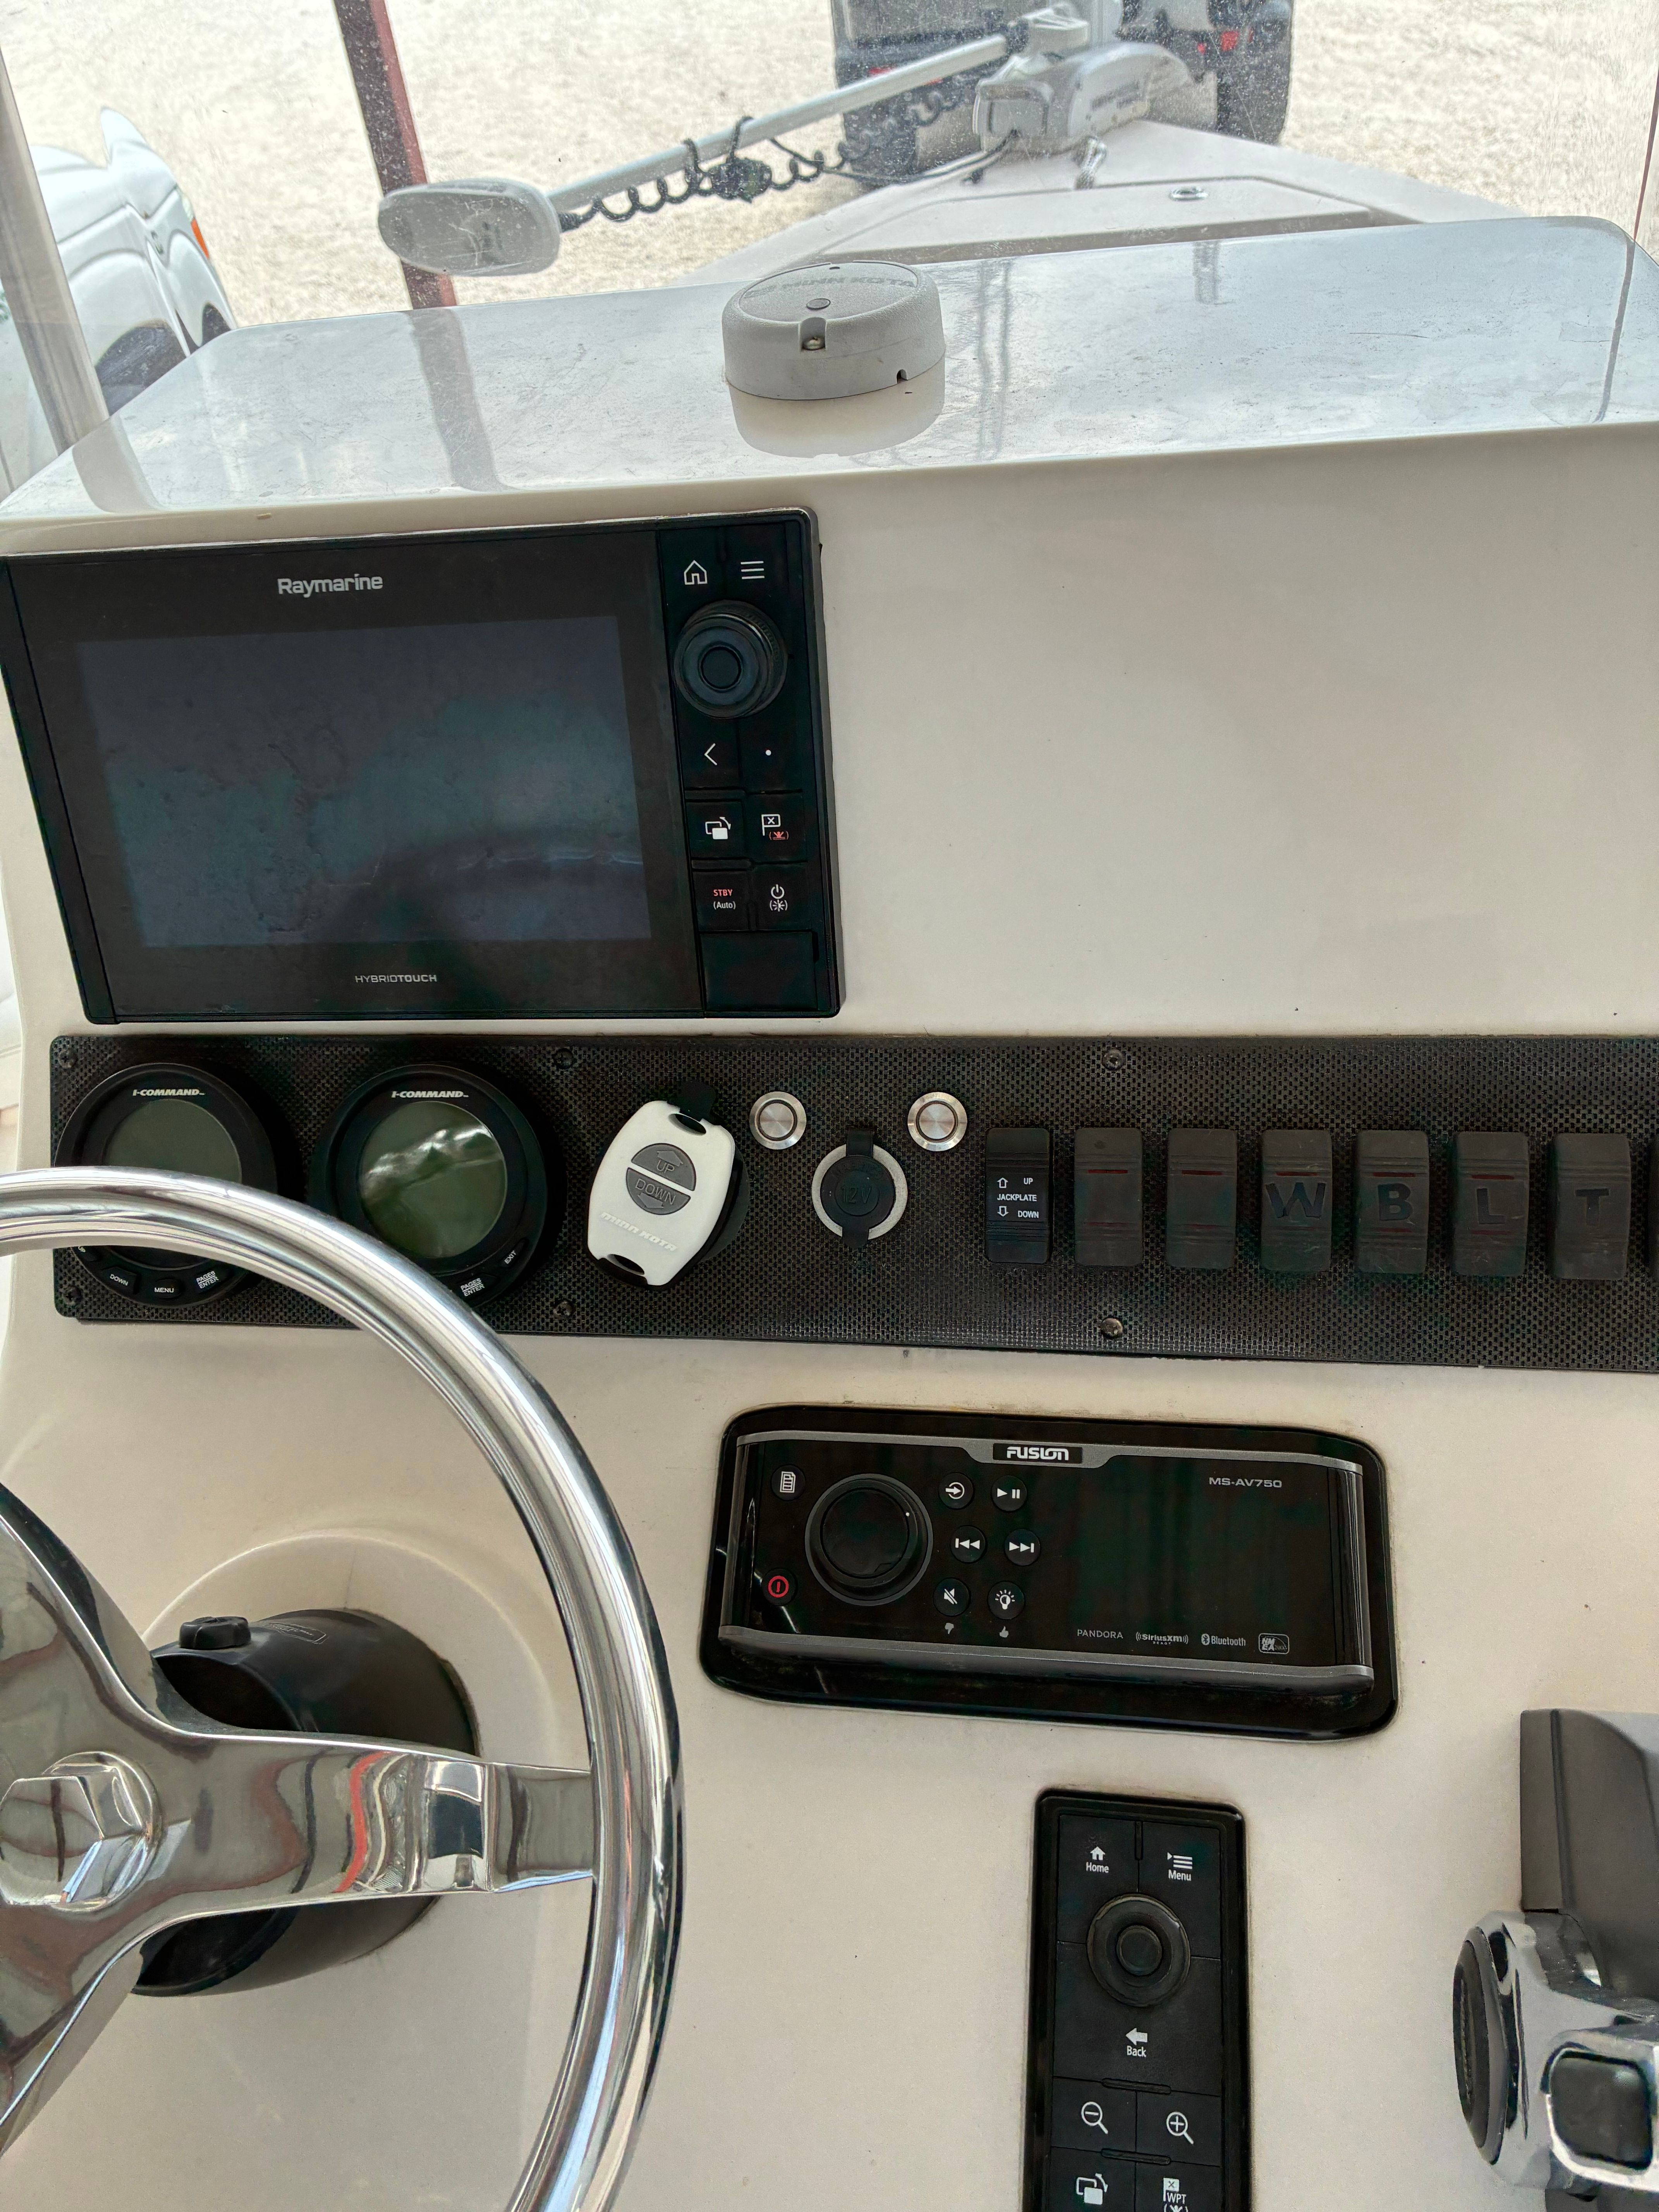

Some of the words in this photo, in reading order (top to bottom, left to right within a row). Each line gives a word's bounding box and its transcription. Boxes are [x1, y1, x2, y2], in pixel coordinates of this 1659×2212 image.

[277, 574, 383, 598] Raymarine
[713, 901, 736, 910] (Auto)
[355, 974, 437, 983] HYBRIDTOUCH
[656, 1160, 675, 1174] UP
[635, 1178, 676, 1205] DOWN
[997, 1194, 1037, 1202] JACKPLATE
[1265, 1182, 1327, 1219] W
[1377, 1183, 1413, 1221] B
[1476, 1188, 1506, 1224] L
[1575, 1188, 1610, 1226] T
[504, 1250, 517, 1264] EXIT
[110, 1274, 129, 1286] DOWN
[196, 1271, 216, 1283] PAGES
[199, 1276, 219, 1289] ENTER
[460, 1278, 482, 1290] PAGES
[464, 1284, 485, 1297] ENTER
[1007, 1446, 1069, 1461] FUSION
[1209, 1477, 1282, 1488] MS-AV750
[1077, 1629, 1123, 1639] PANDORA
[1086, 1862, 1109, 1873] Home
[1168, 1869, 1191, 1881] Menu
[1127, 2045, 1146, 2057] Back
[1167, 2192, 1187, 2205] WPT
